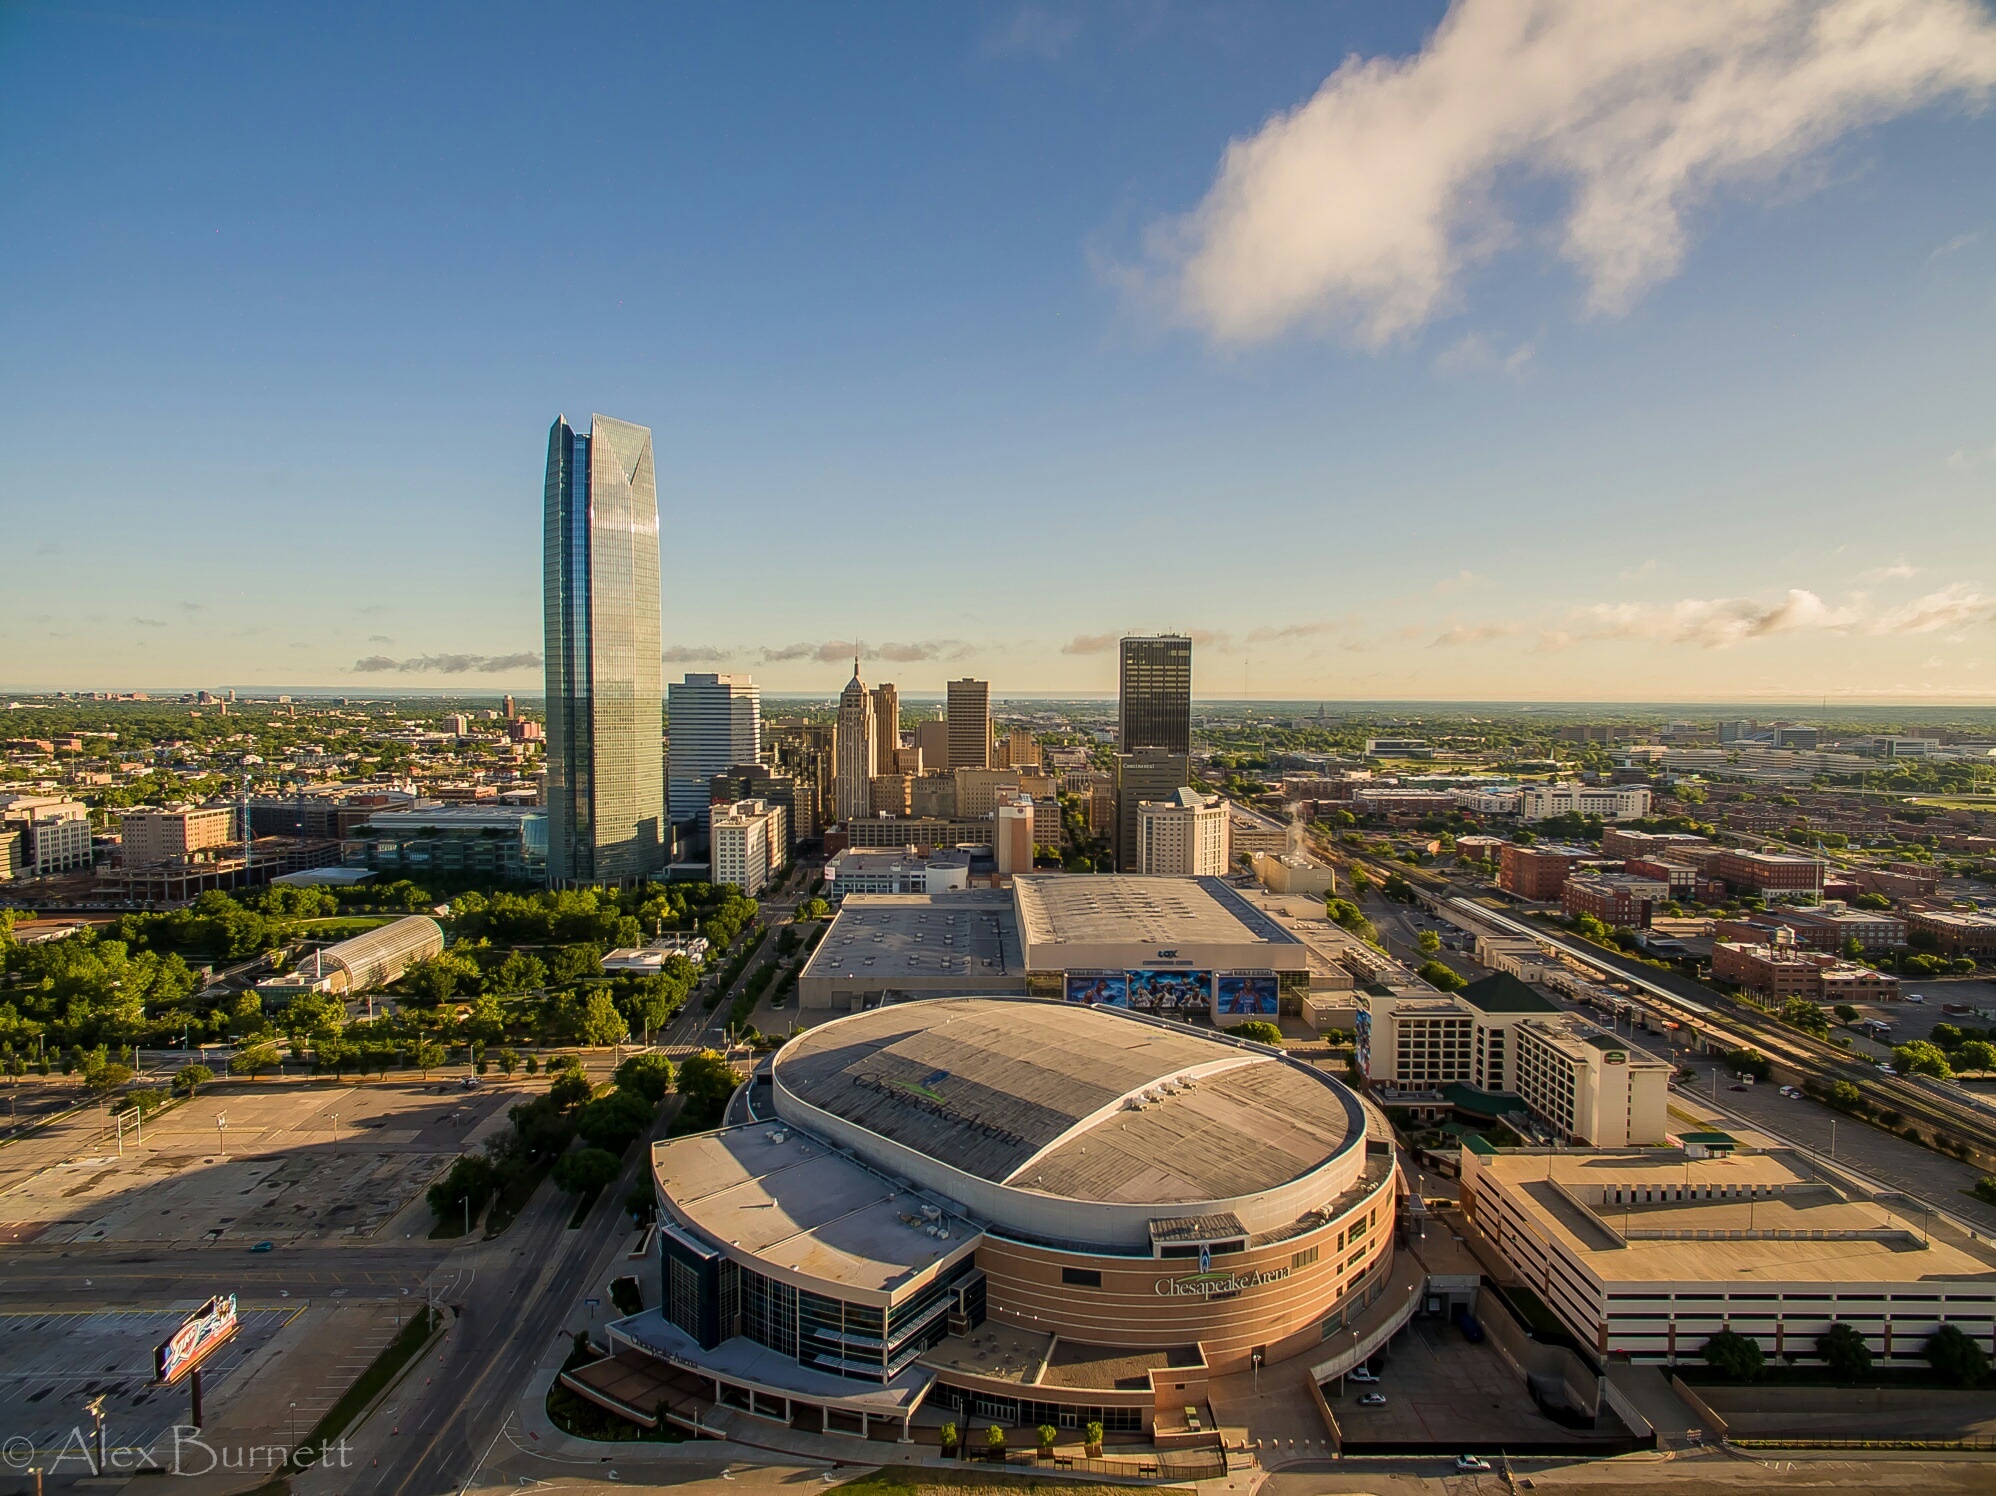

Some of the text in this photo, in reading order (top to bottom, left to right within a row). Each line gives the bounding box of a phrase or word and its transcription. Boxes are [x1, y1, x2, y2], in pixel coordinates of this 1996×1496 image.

[1155, 1272, 1249, 1300] Chesapeake
[1249, 1266, 1292, 1286] Arena
[673, 1351, 699, 1369] Arena
